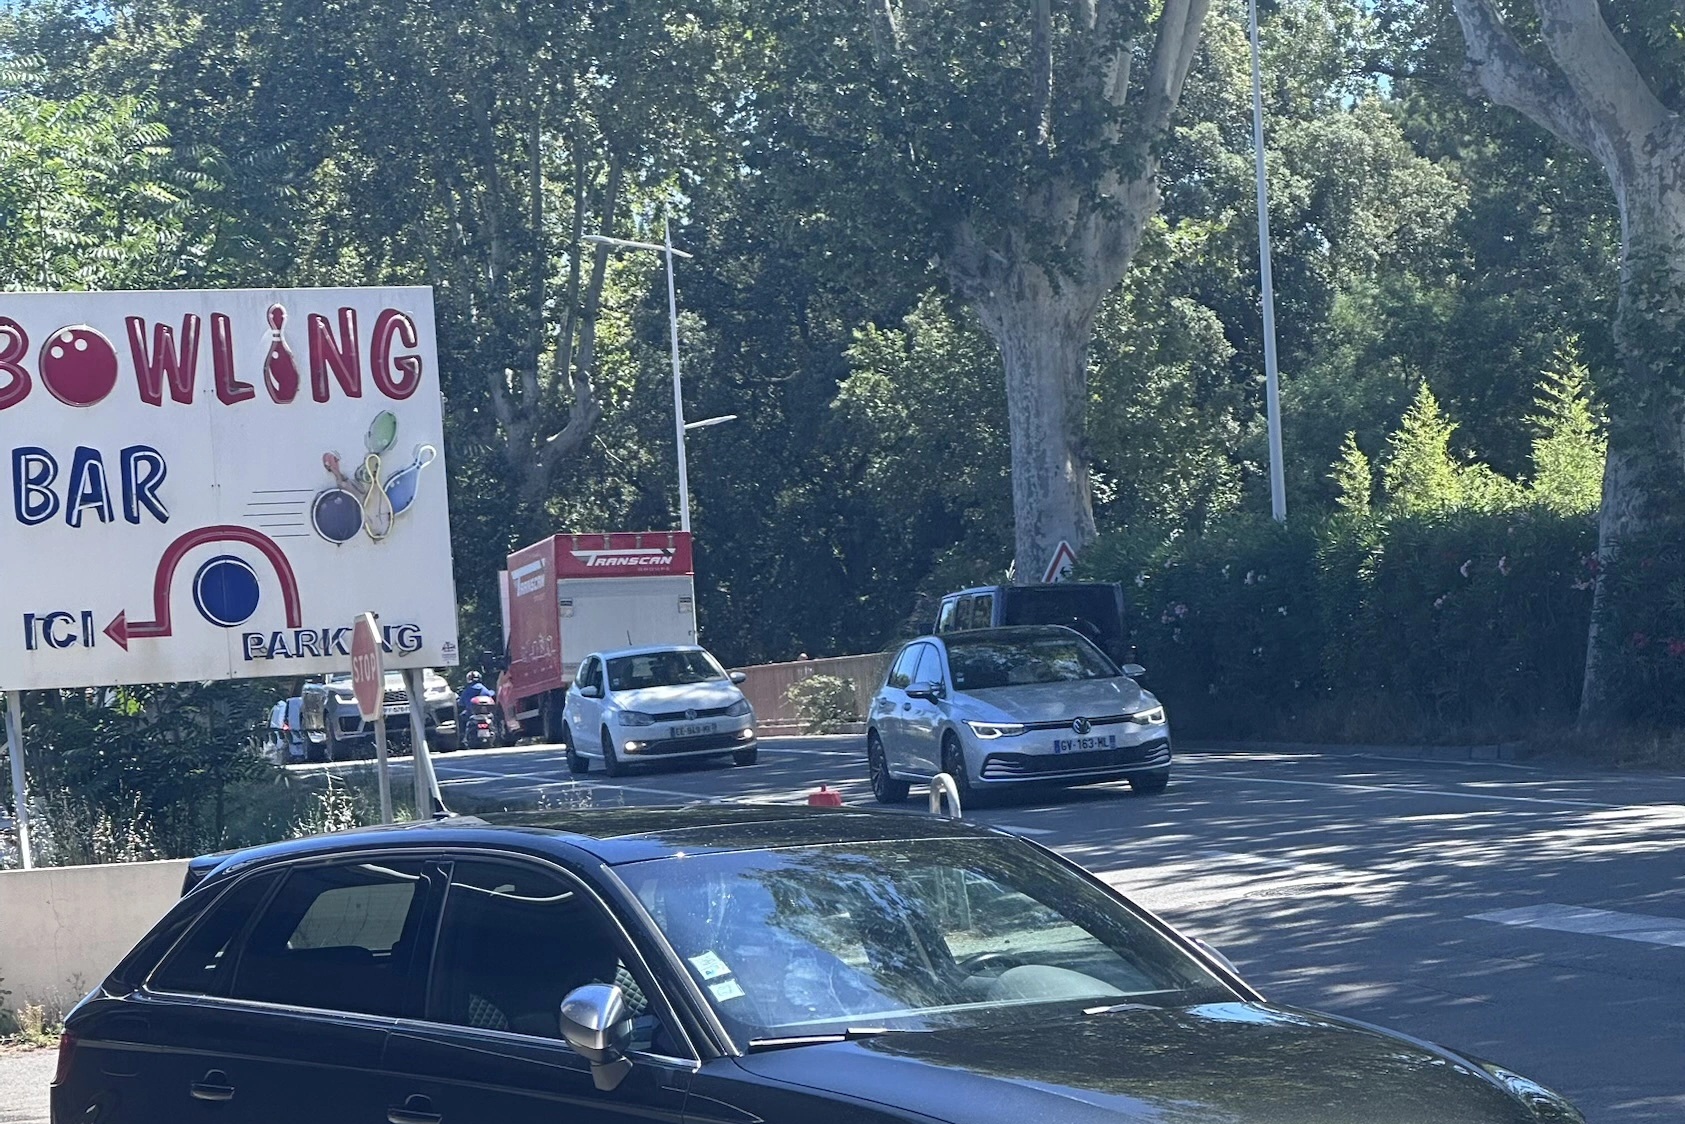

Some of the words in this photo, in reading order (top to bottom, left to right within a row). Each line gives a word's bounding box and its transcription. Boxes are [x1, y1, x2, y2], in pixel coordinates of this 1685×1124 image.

[12, 444, 170, 528] BAR
[570, 548, 676, 567] TRANSCAN
[23, 610, 96, 651] ICI
[242, 623, 423, 661] PARKNG
[353, 652, 376, 684] STOP
